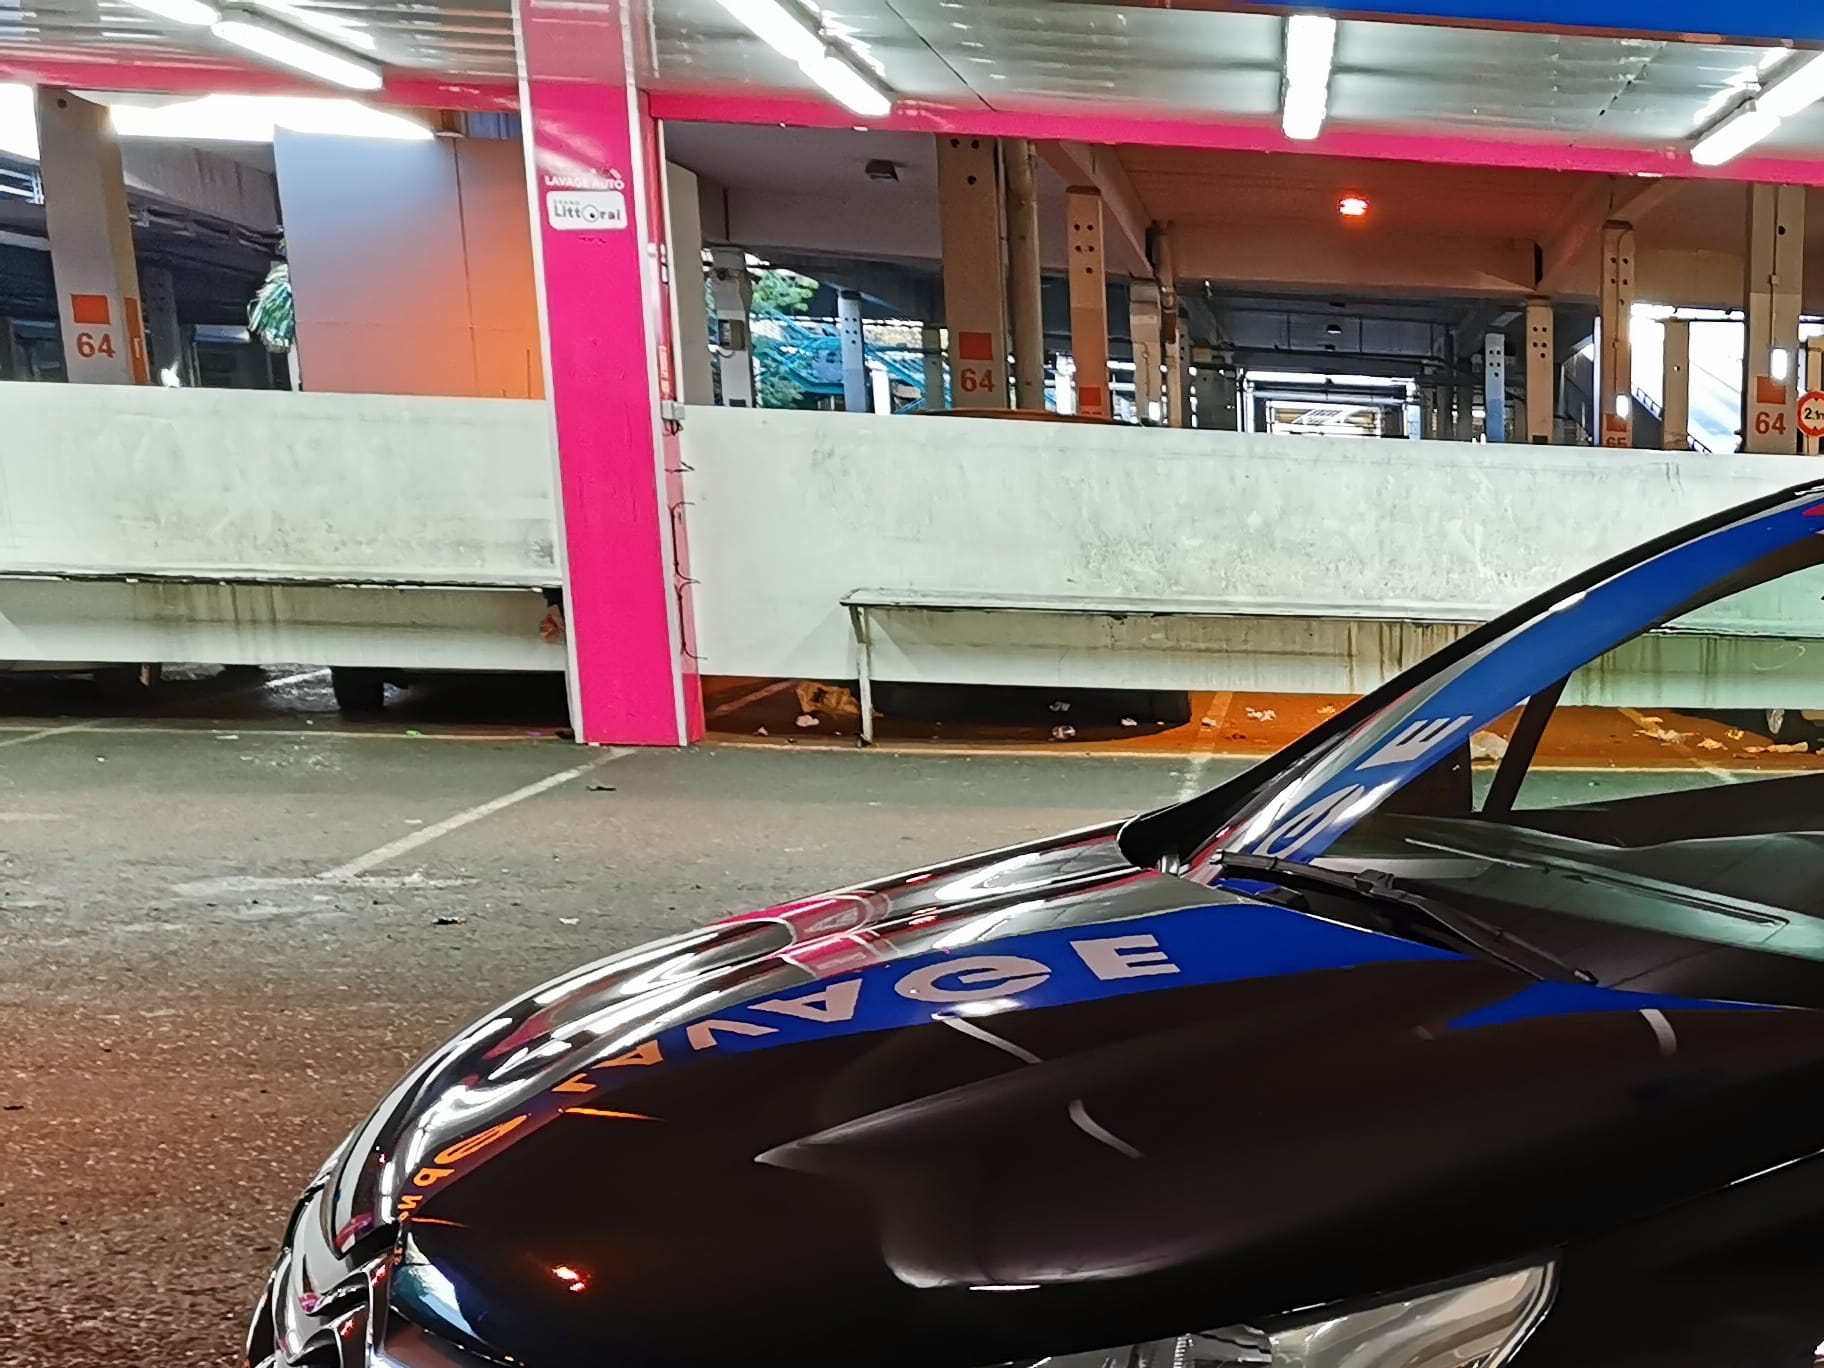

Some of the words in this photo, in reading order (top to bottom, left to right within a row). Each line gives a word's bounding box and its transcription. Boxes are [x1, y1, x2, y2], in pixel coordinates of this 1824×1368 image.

[544, 175, 592, 189] LAVAGE
[76, 332, 116, 358] 64
[960, 366, 995, 393] 64
[1755, 411, 1786, 435] 64
